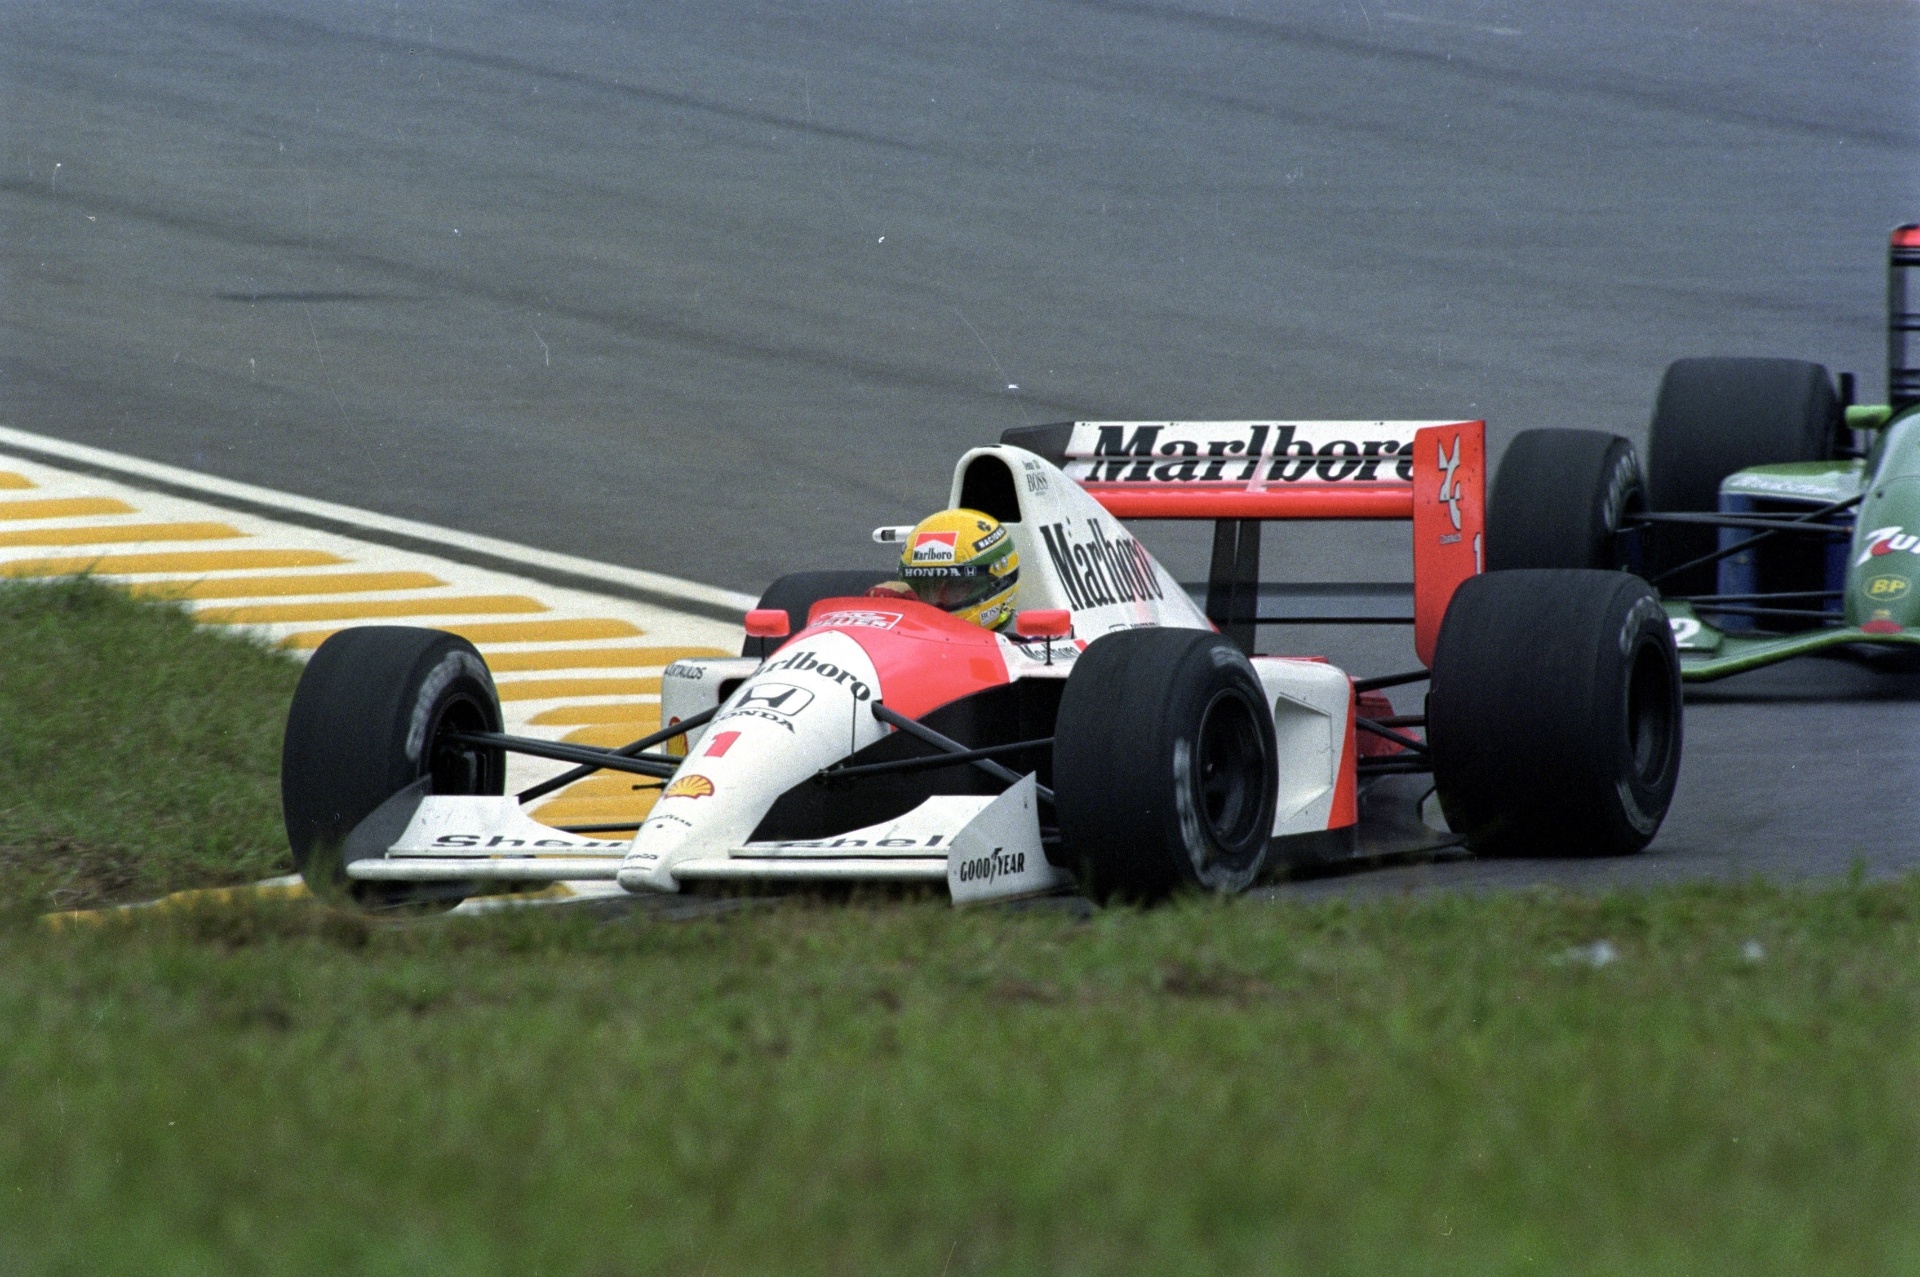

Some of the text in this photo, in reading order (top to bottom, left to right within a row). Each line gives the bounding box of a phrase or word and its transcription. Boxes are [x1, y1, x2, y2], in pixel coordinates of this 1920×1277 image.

[913, 548, 952, 561] Marlboro
[1039, 517, 1164, 612] Marlboro
[904, 567, 961, 577] HONDA
[1871, 579, 1906, 594] BP
[748, 651, 871, 702] rlboro
[714, 710, 796, 734] ONDA
[703, 730, 742, 758] 1
[960, 847, 1026, 884] GOODYEAR
